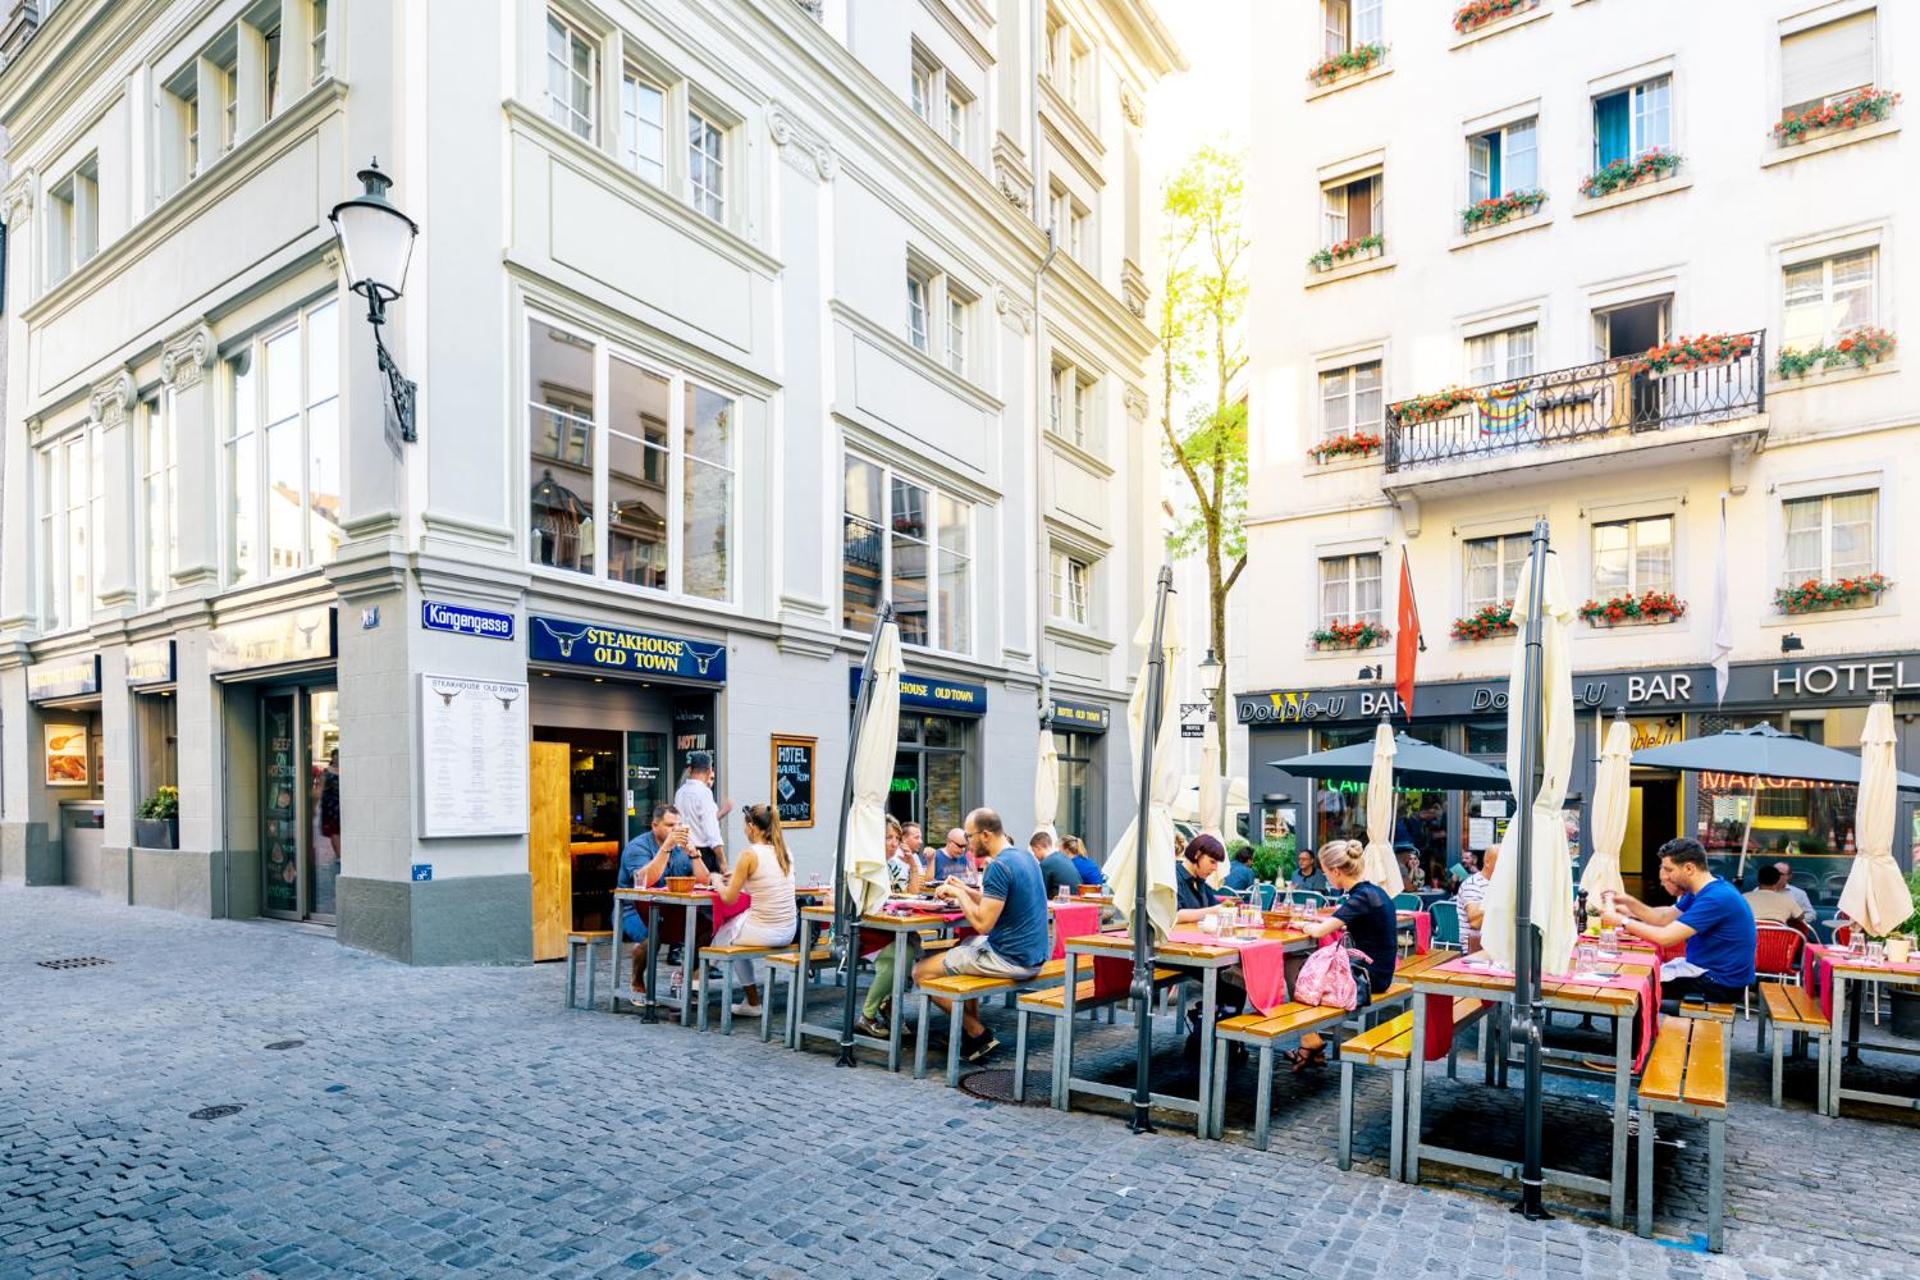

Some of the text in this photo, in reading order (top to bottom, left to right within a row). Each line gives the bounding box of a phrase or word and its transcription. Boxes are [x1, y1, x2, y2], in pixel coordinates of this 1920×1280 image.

[429, 604, 509, 633] Köngengasse
[587, 629, 684, 656] STEAKHOUSE
[594, 647, 679, 672] OLD TOWN
[1627, 674, 1691, 702] BAR
[1773, 661, 1920, 695] HOTEL
[1239, 696, 1345, 720] Double-U
[778, 747, 807, 763] HOTEL
